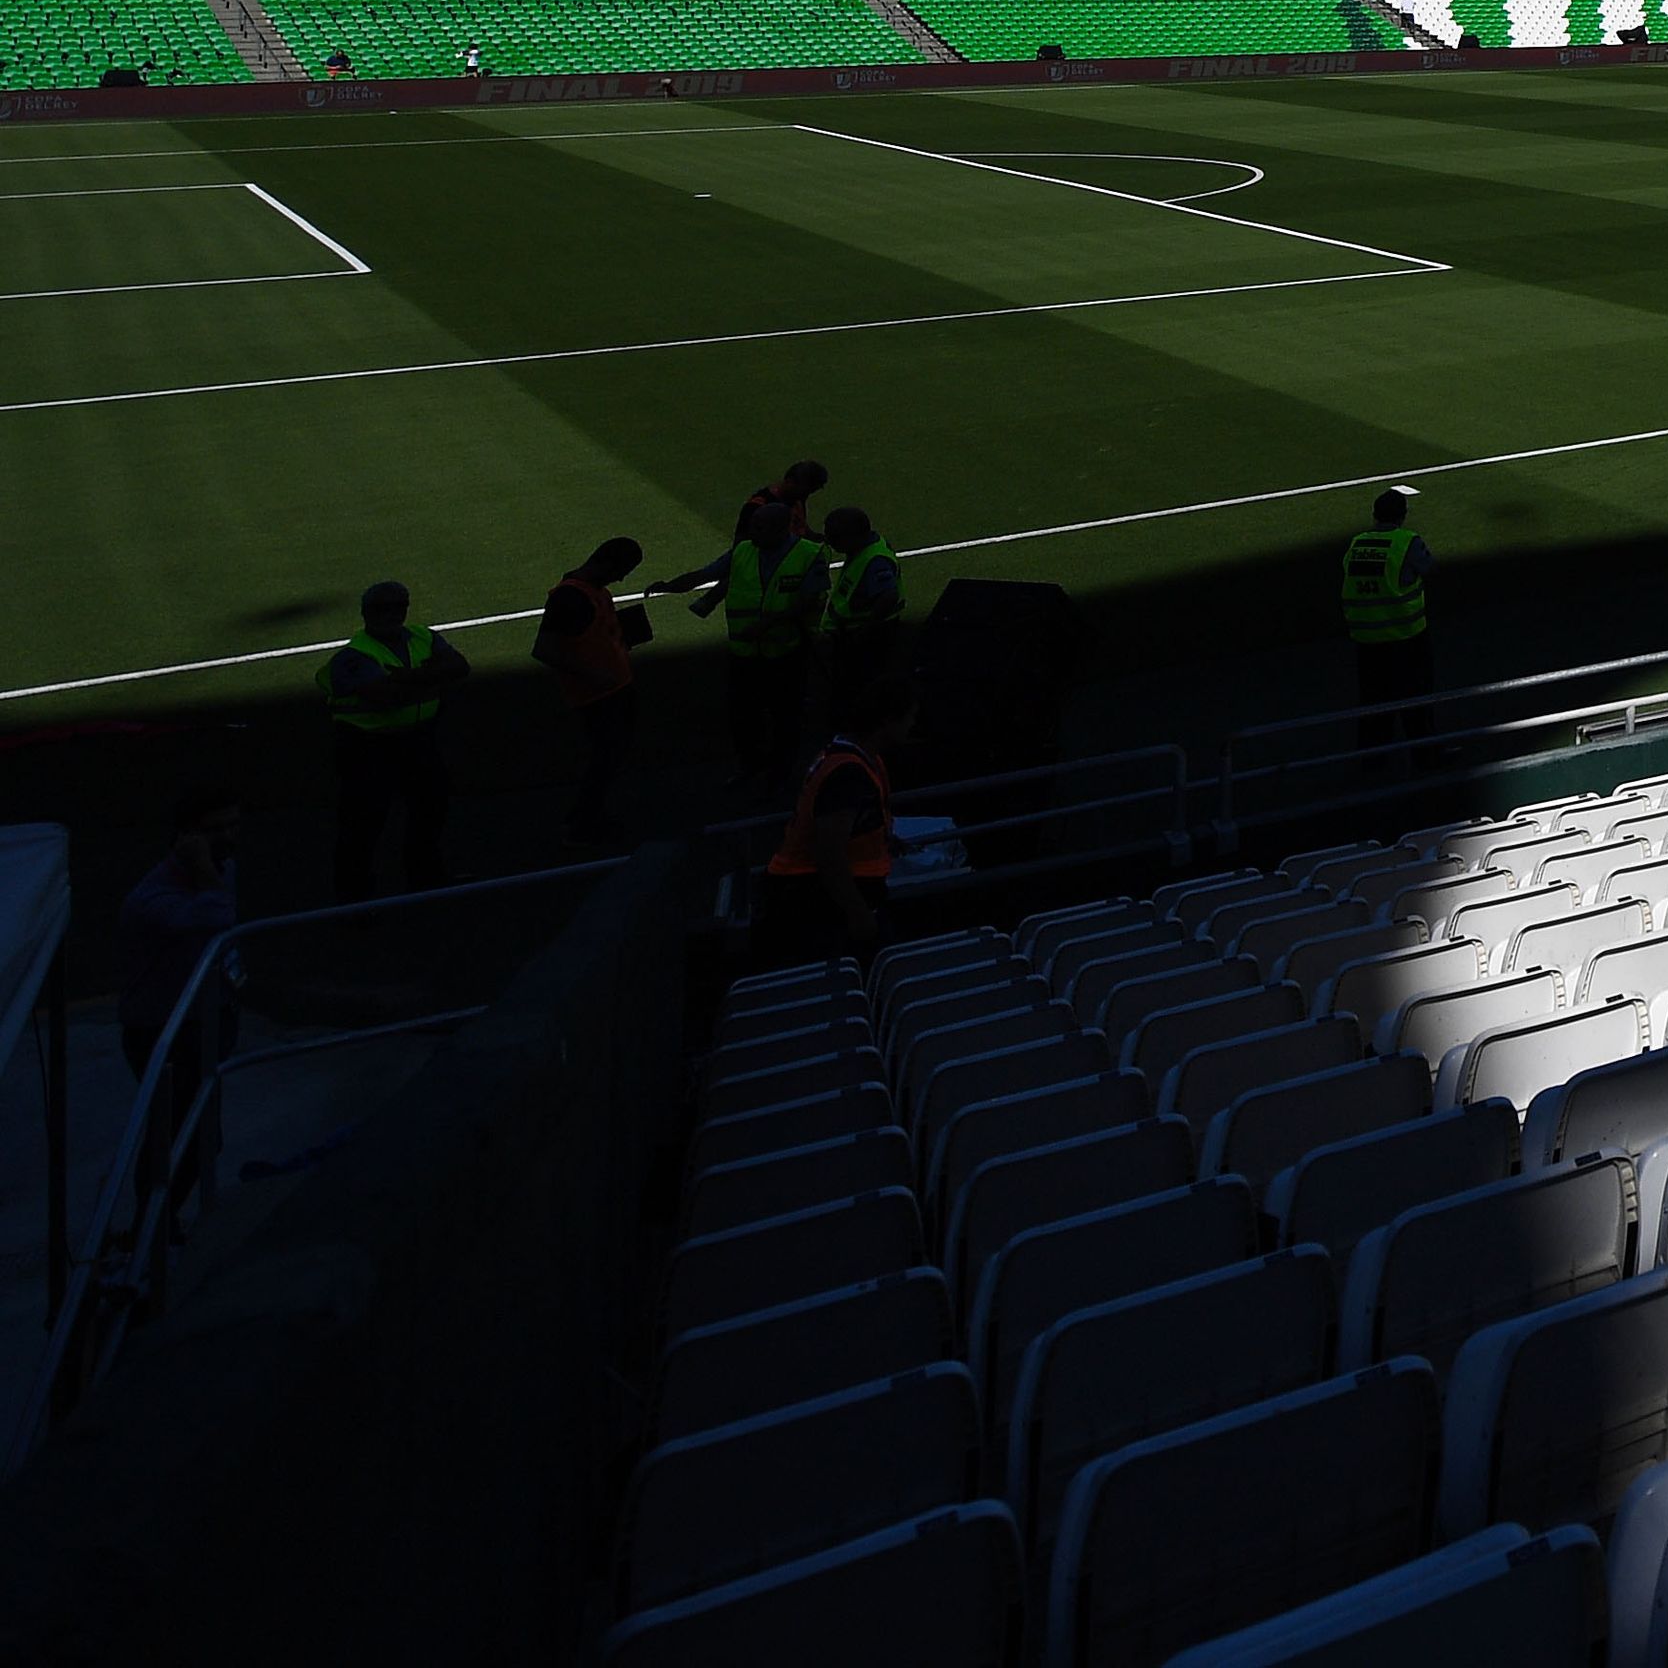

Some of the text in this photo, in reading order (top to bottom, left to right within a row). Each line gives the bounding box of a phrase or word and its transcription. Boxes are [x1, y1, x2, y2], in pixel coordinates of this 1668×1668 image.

[1168, 55, 1357, 78] FINAL 2019
[25, 95, 62, 103] COPA
[476, 78, 632, 102] FINAL
